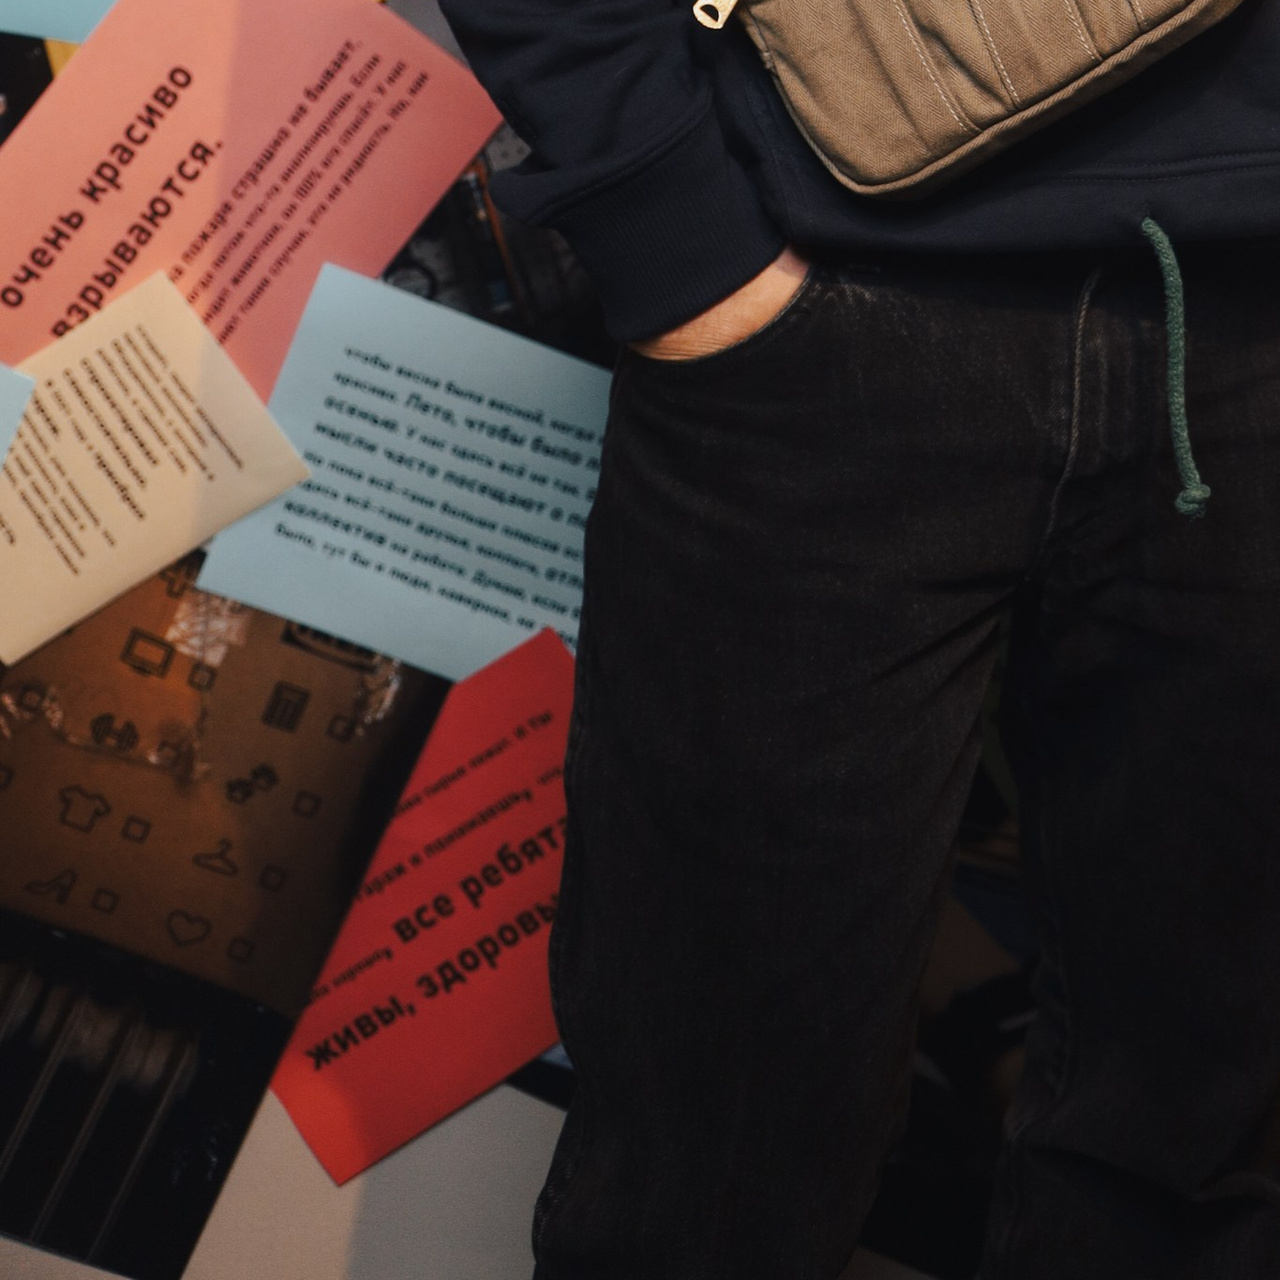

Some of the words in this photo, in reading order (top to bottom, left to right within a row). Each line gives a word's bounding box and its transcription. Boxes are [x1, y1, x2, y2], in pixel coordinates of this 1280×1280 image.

[0, 210, 85, 308] очень
[79, 66, 193, 204] красиво
[390, 893, 456, 944] все
[459, 815, 568, 907] ребят
[305, 996, 417, 1072] живы,
